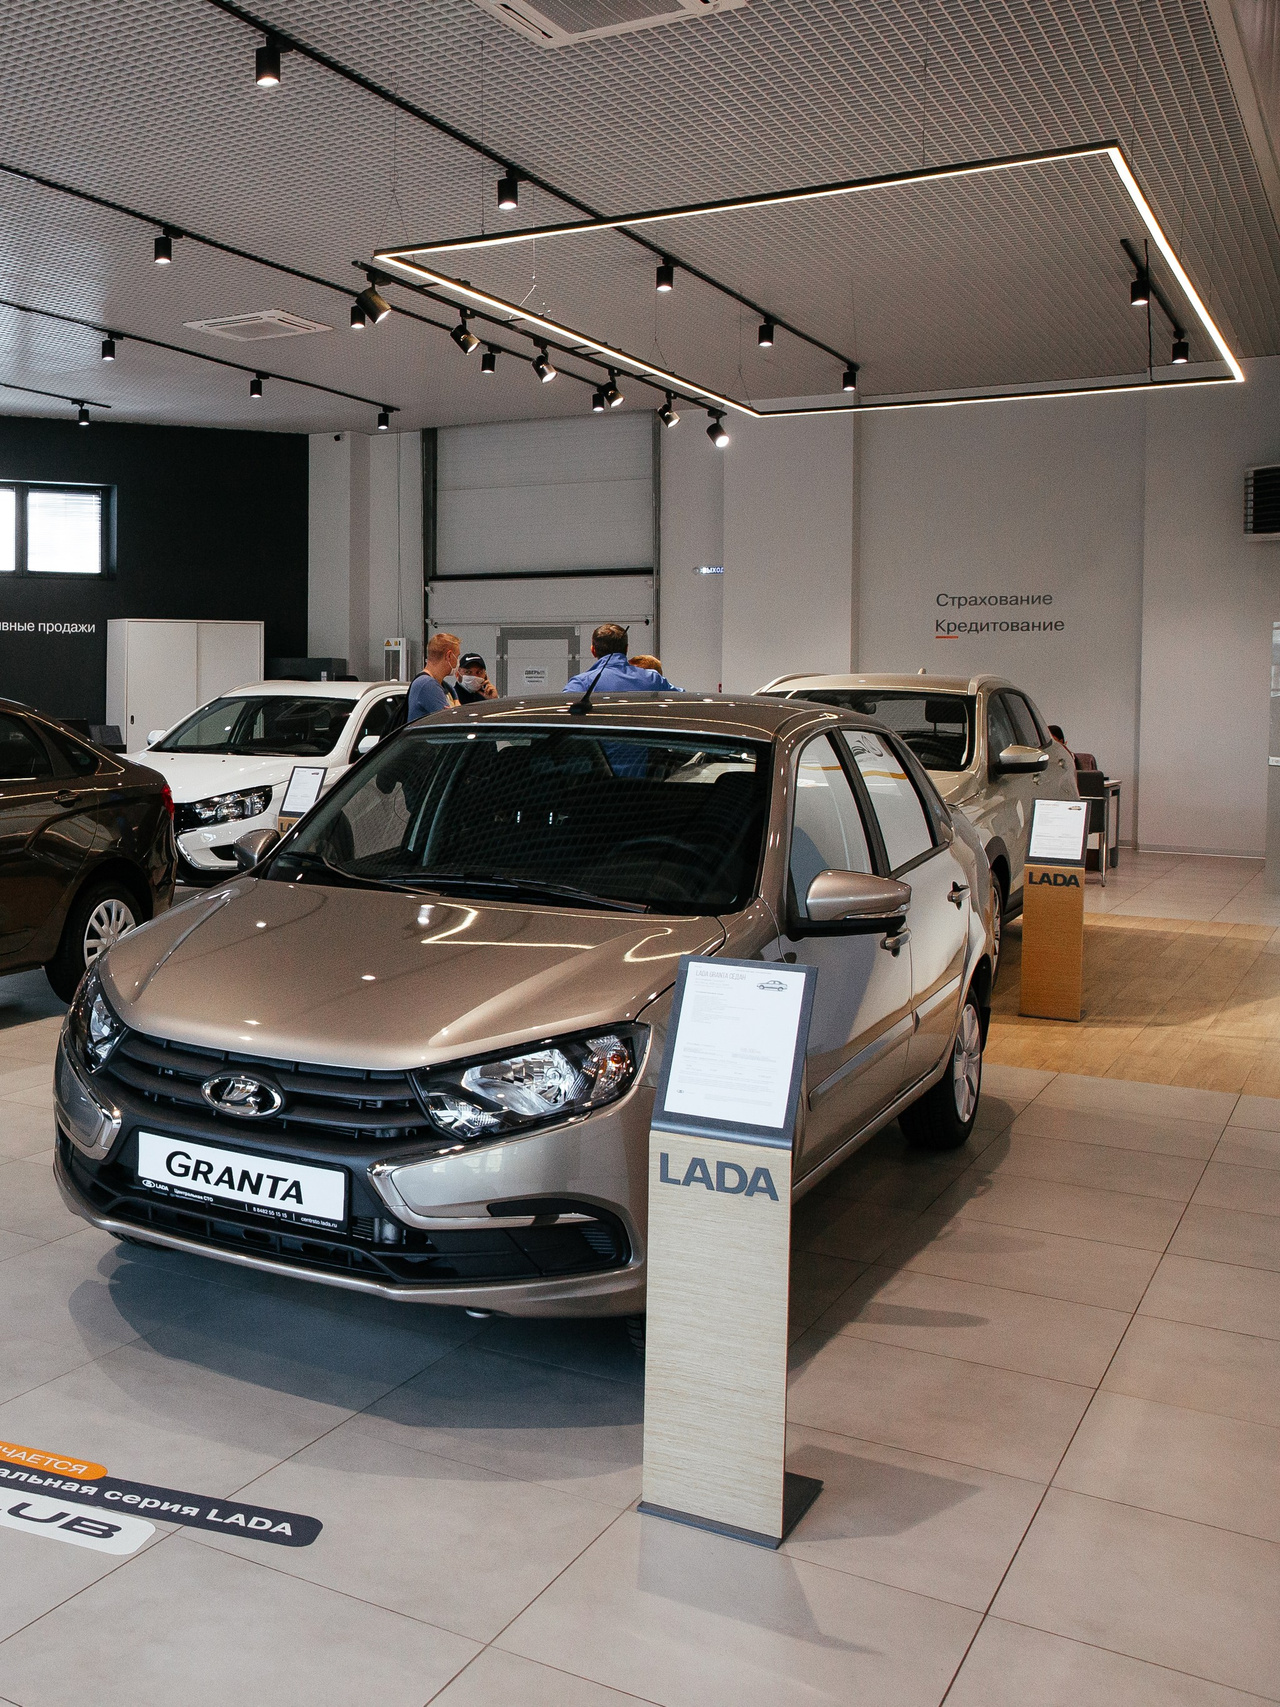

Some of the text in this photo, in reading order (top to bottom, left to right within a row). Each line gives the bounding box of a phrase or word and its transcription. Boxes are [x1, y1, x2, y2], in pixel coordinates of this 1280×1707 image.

[936, 593, 1053, 609] Страхование
[38, 622, 95, 634] продажи
[935, 619, 1065, 635] Кредитование
[1028, 871, 1080, 888] LADA
[165, 1150, 304, 1205] GRANTA
[659, 1152, 780, 1202] LADA
[155, 1183, 169, 1192] LADA
[104, 1488, 198, 1517] серия
[206, 1508, 293, 1537] LADA
